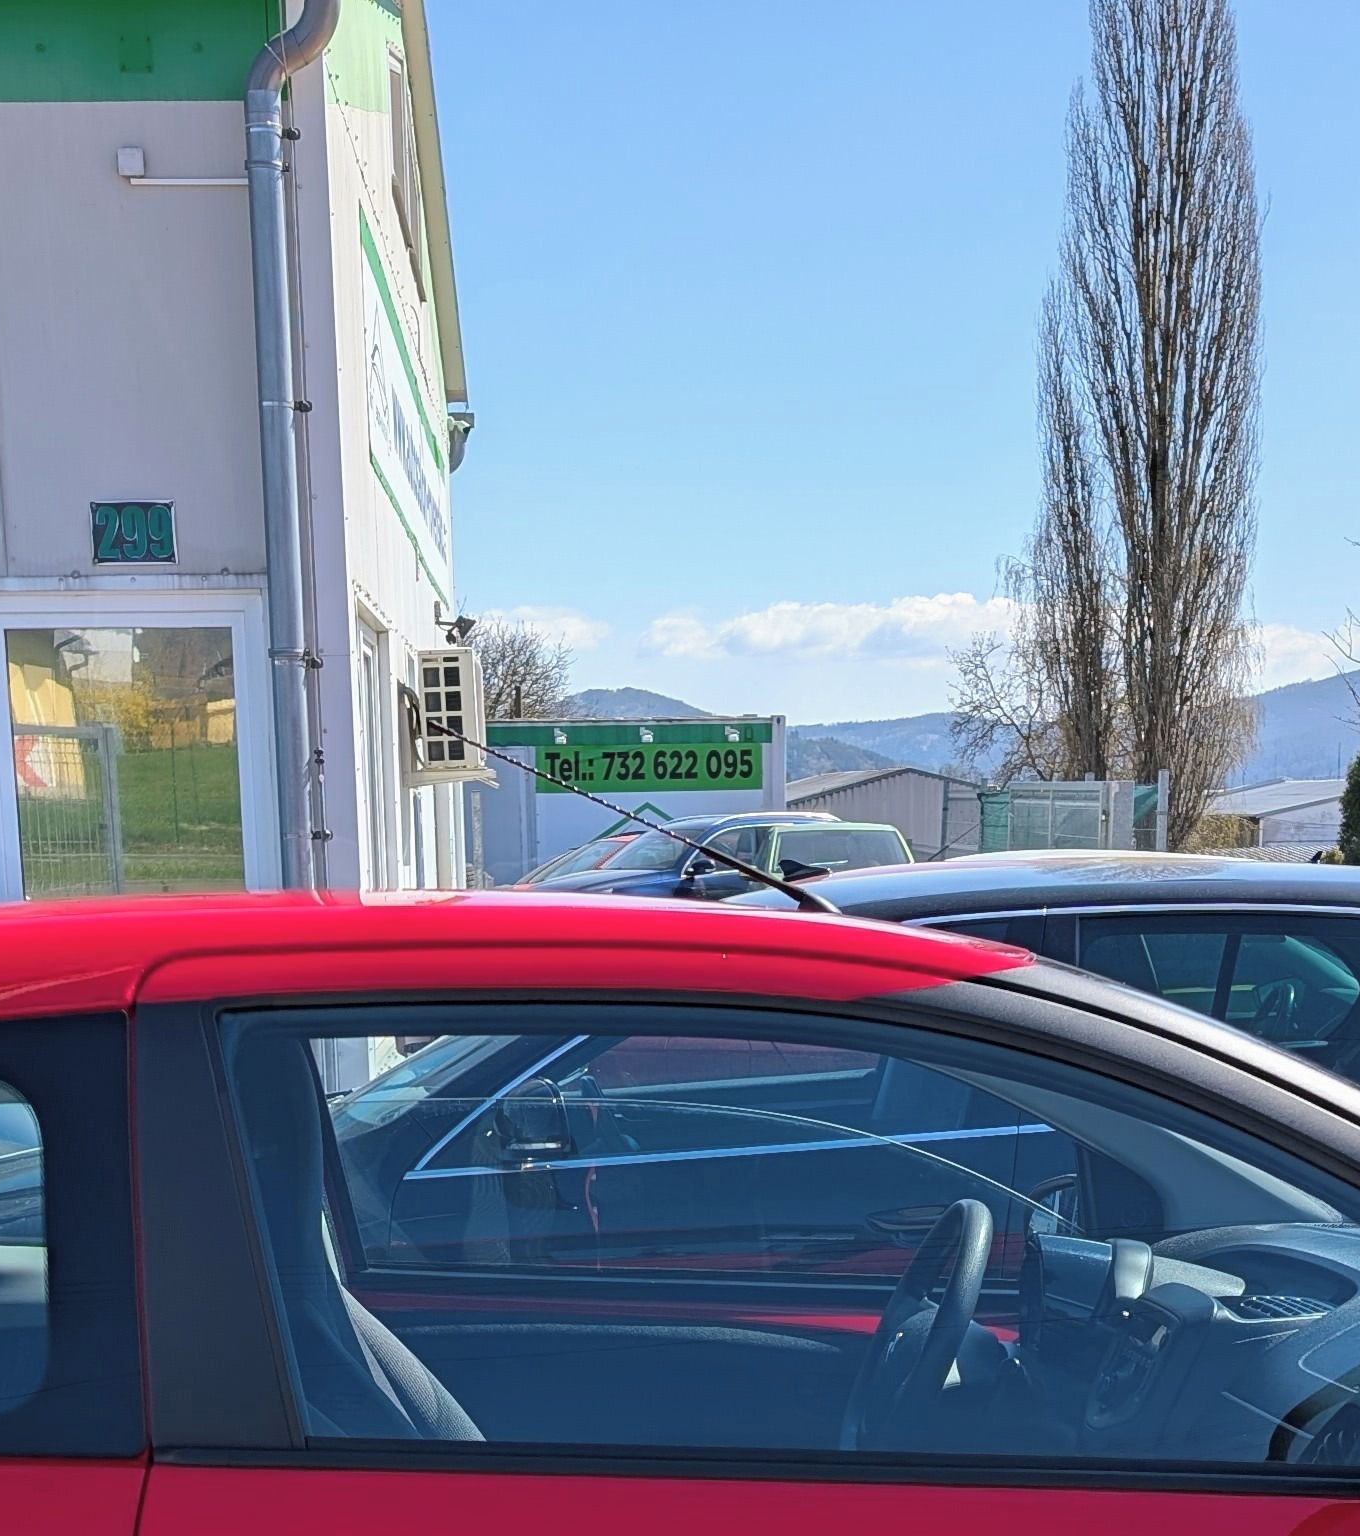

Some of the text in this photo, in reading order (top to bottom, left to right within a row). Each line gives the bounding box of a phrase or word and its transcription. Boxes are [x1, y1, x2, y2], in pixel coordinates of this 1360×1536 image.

[95, 504, 174, 559] 299
[544, 749, 753, 782] Tel.: 732 622 095
